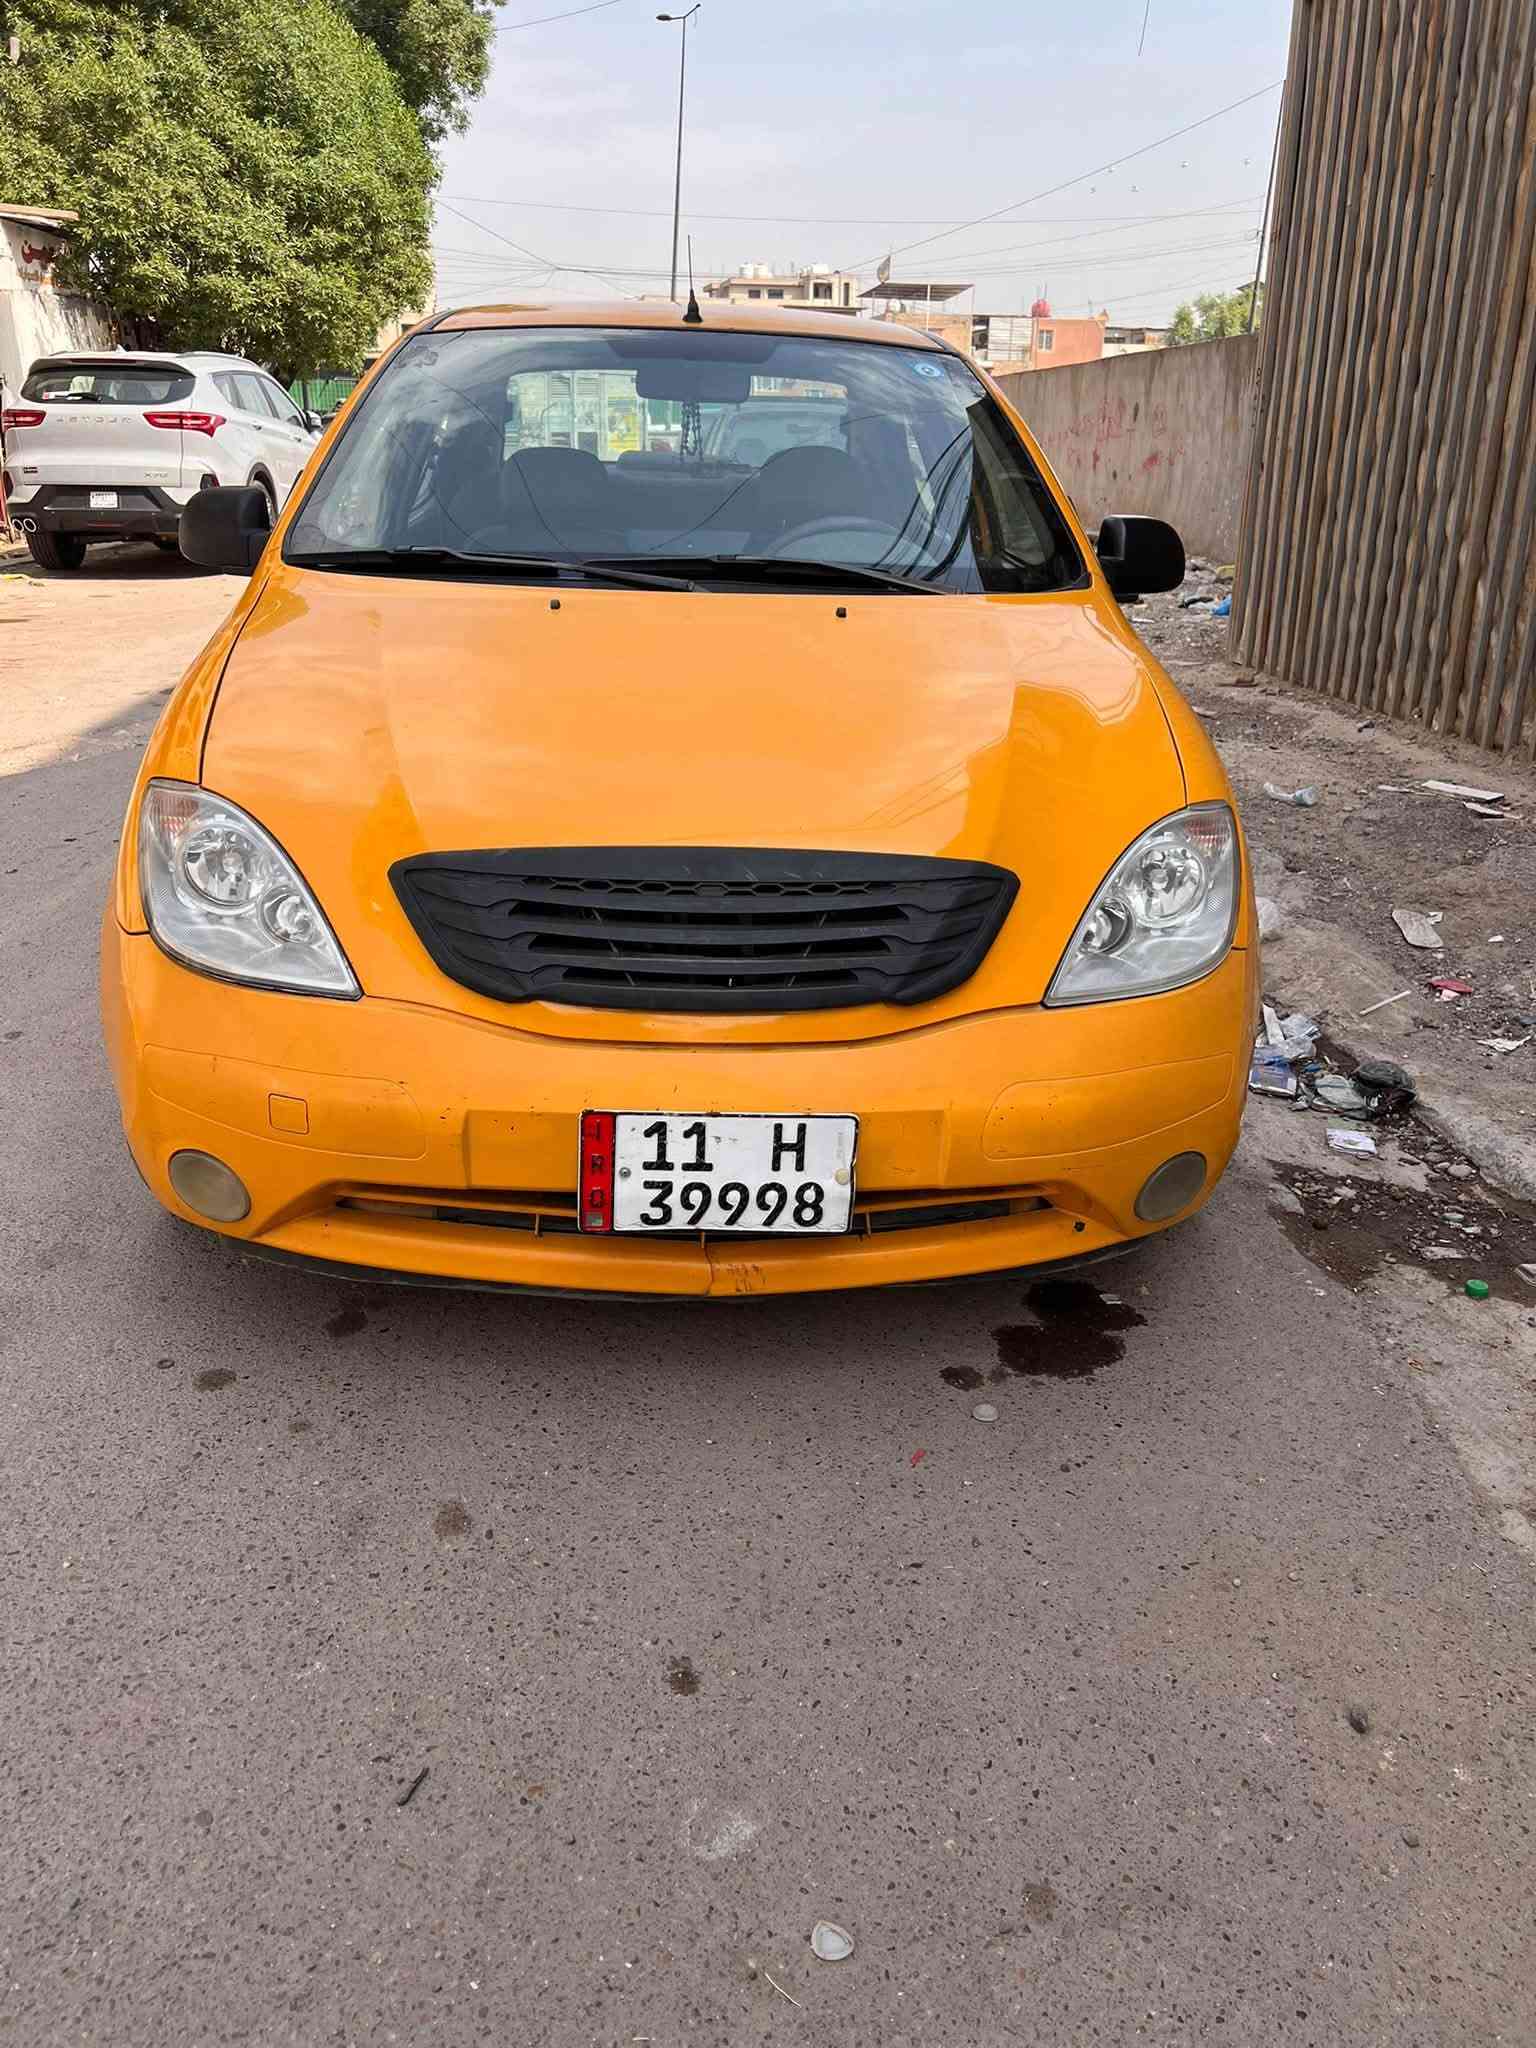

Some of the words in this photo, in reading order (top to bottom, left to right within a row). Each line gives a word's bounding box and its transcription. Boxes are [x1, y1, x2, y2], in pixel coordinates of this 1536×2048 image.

[642, 1121, 713, 1171] 11
[771, 1122, 807, 1172] H
[640, 1180, 825, 1227] 39998
